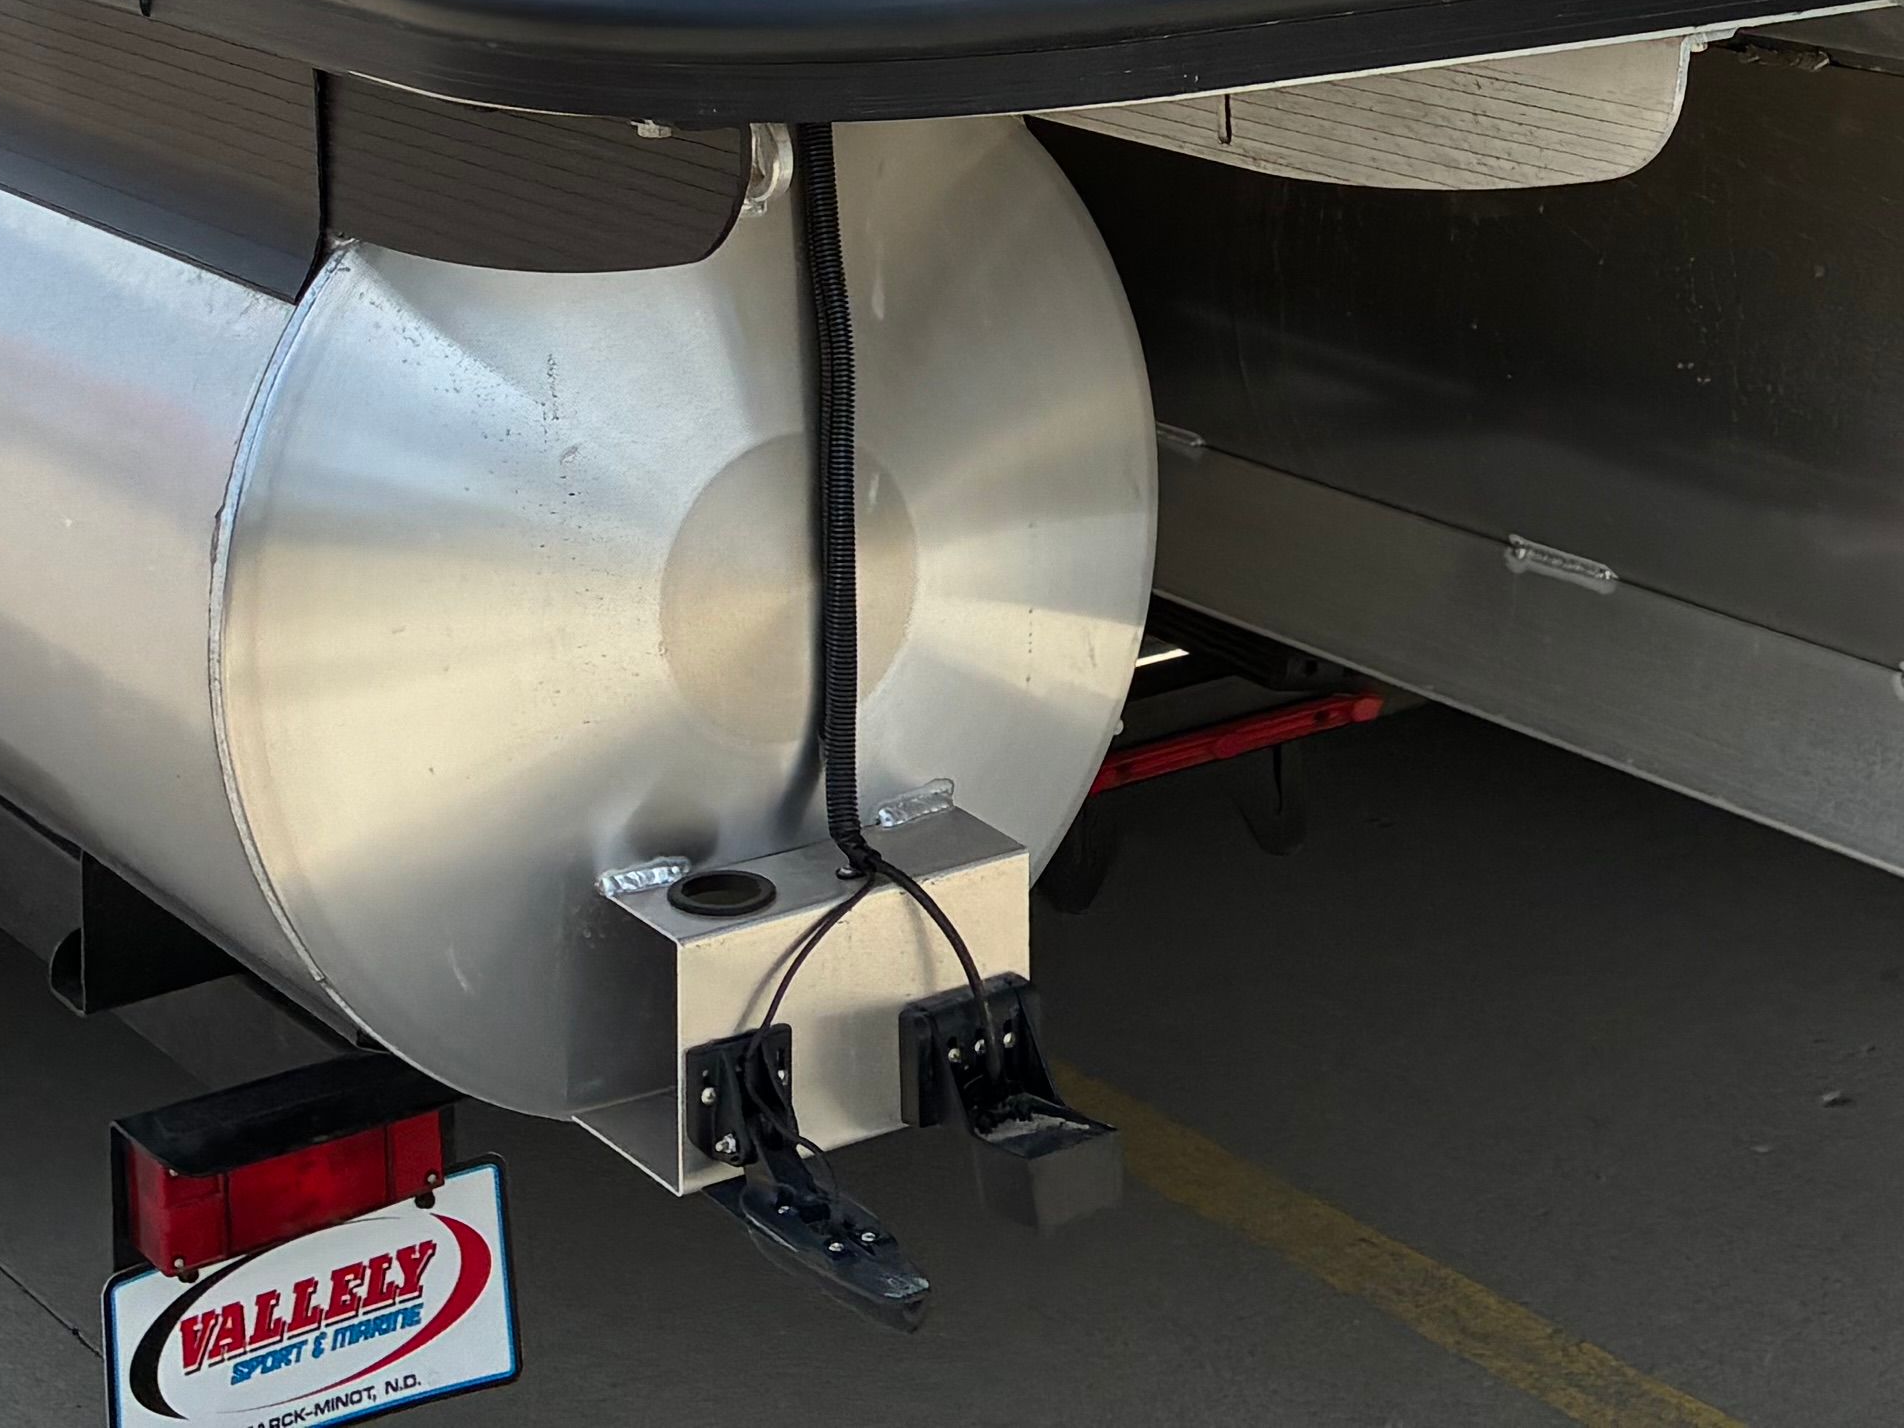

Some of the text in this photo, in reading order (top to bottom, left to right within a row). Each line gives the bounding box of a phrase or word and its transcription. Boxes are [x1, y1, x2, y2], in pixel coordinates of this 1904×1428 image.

[180, 1239, 438, 1376] VALLELY
[230, 1339, 309, 1386] SPORT
[311, 1331, 327, 1359] &
[384, 1373, 422, 1396] N.D.
